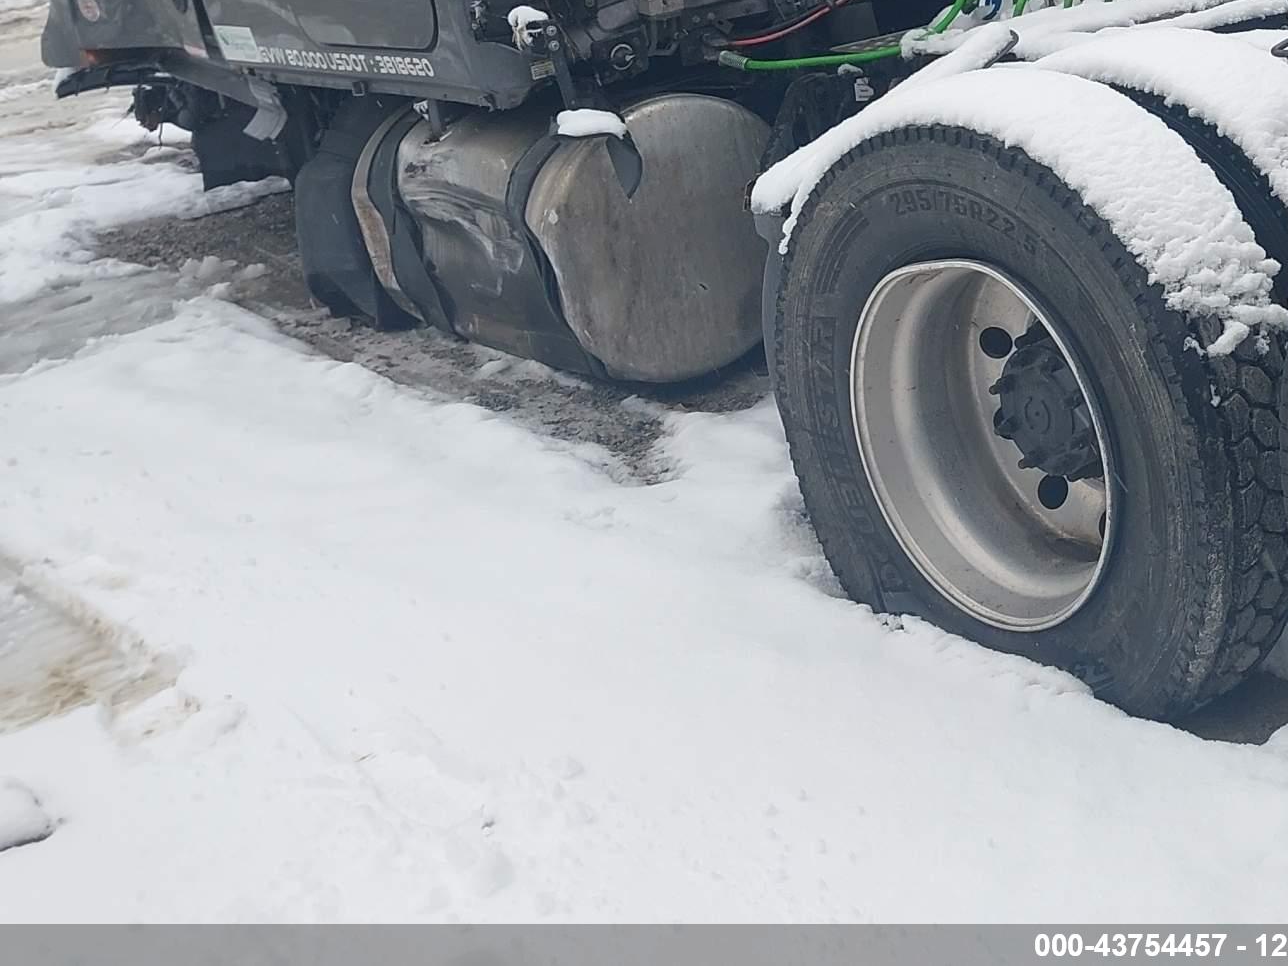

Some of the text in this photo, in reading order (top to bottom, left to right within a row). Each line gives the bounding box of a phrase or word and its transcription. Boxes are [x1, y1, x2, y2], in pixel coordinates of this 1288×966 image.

[285, 48, 328, 71] 80,000
[325, 52, 369, 73] USDOT
[374, 54, 435, 77] 3818620
[888, 187, 1037, 257] 295/75R22.5
